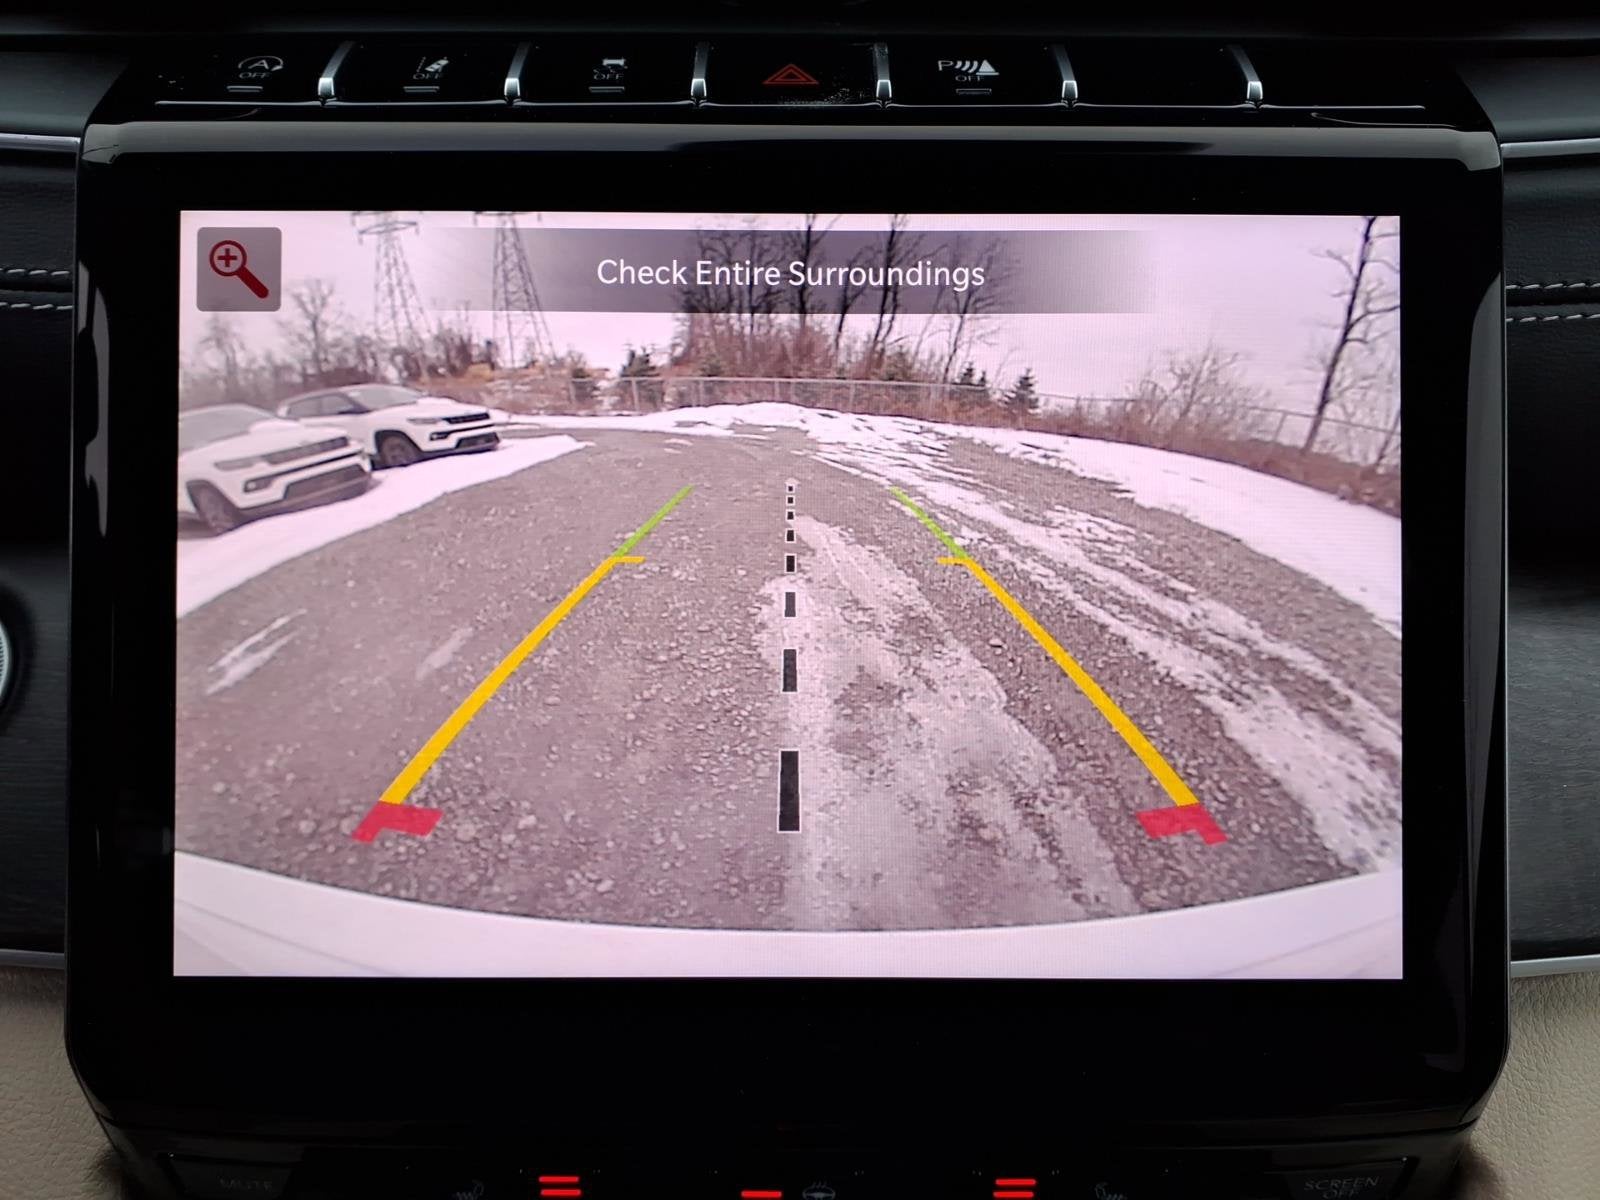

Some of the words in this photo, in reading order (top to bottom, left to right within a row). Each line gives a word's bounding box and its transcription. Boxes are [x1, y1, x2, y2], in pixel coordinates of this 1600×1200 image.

[238, 71, 272, 80] OFF
[412, 72, 444, 80] OFF
[593, 72, 625, 80] OFF
[954, 74, 985, 83] OFF
[597, 258, 688, 285] Check
[696, 259, 781, 286] Entire
[788, 260, 985, 293] Surroundings
[1303, 1176, 1380, 1191] SCREEN
[1321, 1188, 1364, 1200] OFF
